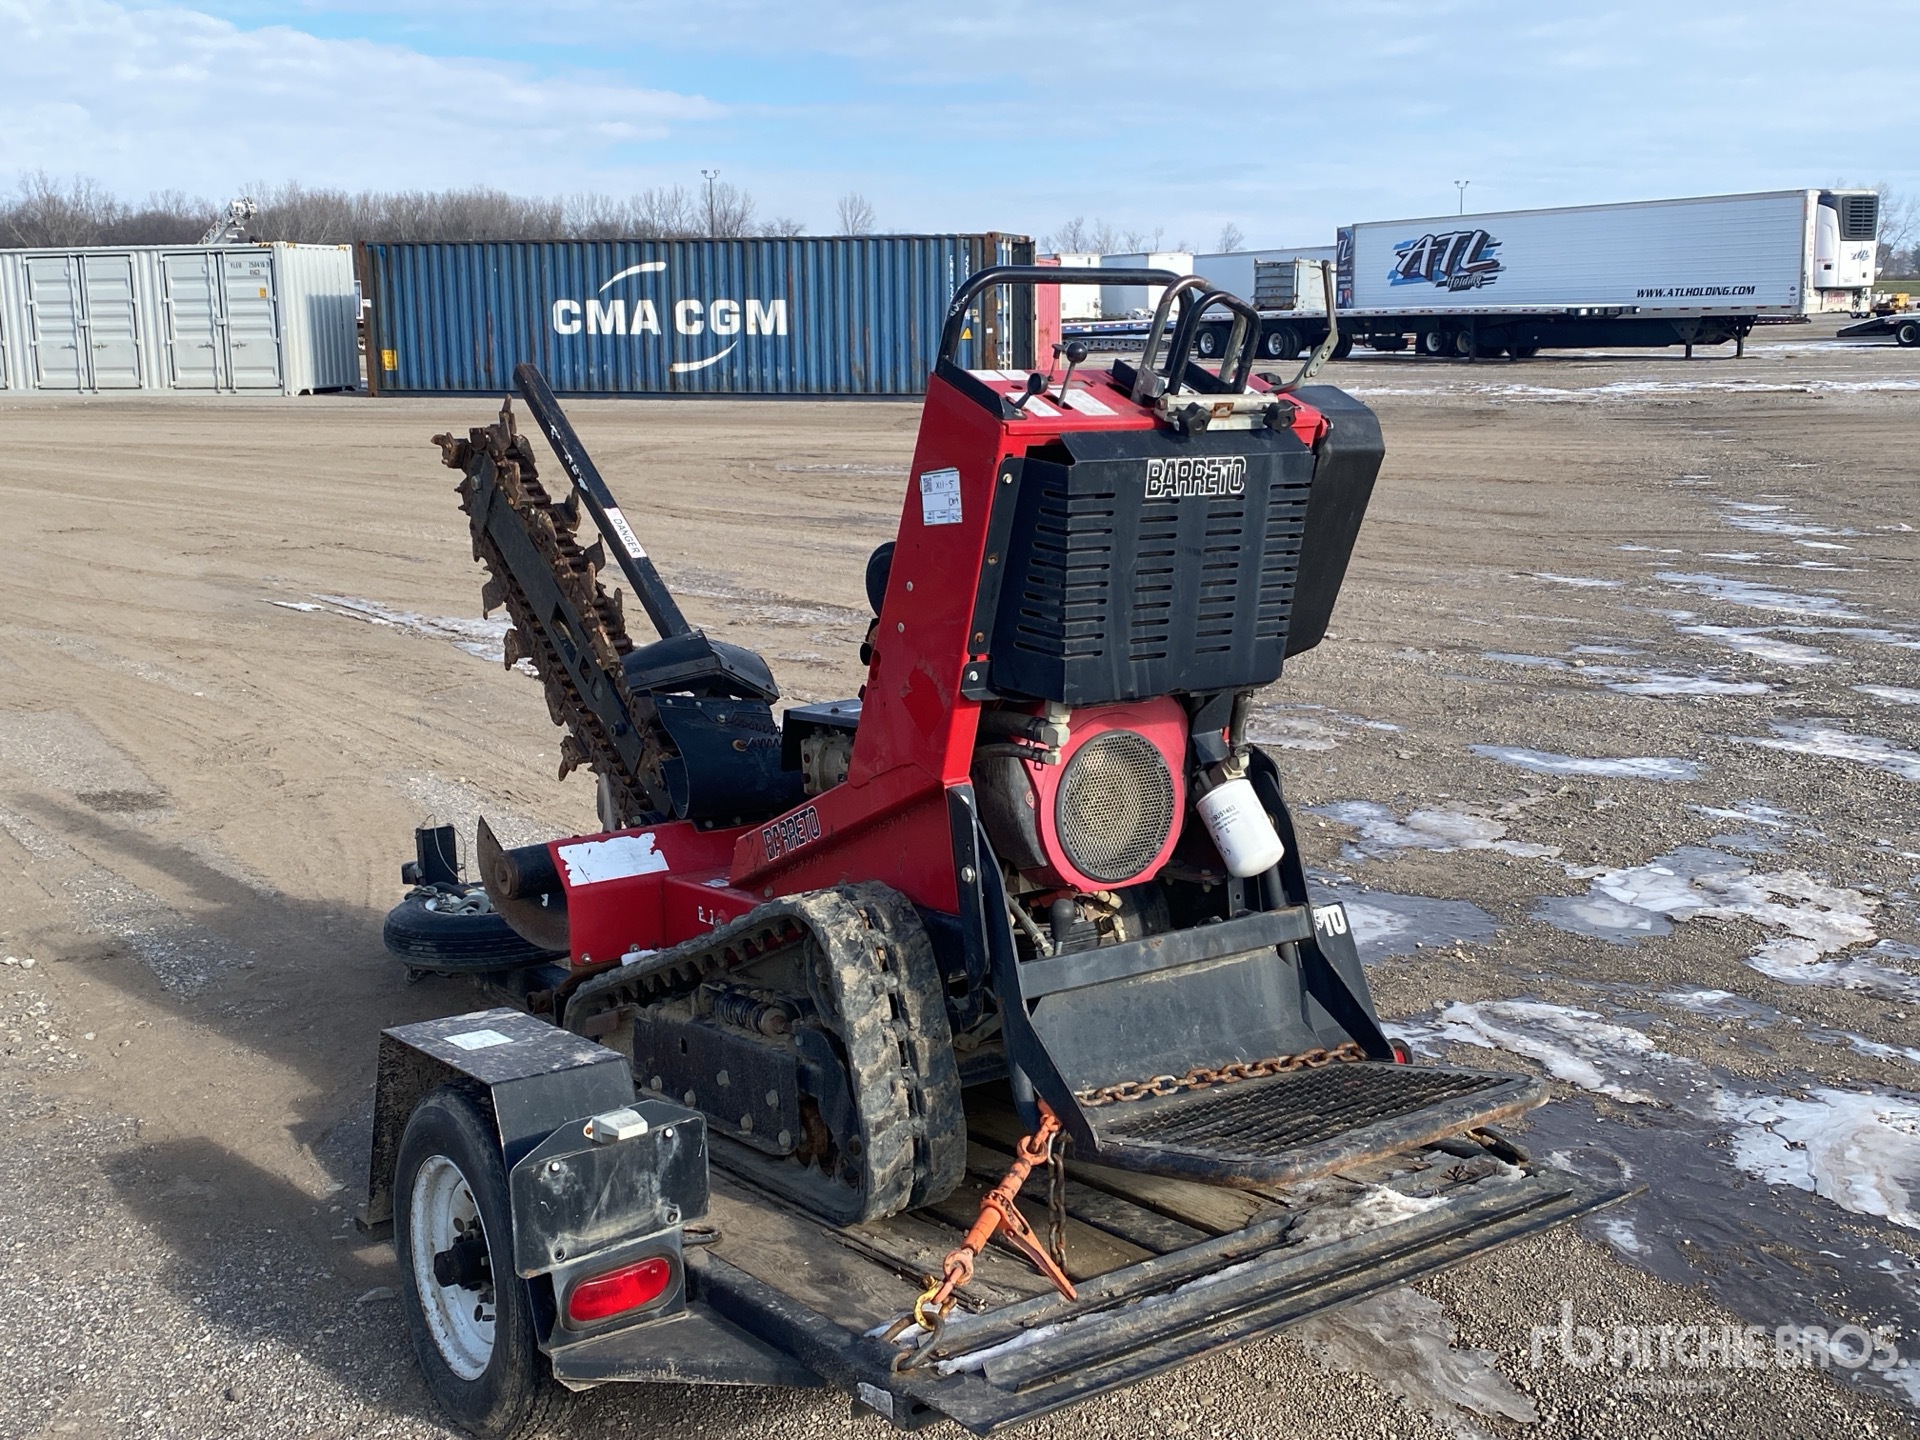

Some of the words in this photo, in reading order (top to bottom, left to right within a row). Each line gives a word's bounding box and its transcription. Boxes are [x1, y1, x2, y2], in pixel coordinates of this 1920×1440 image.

[1395, 229, 1500, 281] ATL
[1447, 275, 1482, 288] Holding
[1636, 286, 1756, 298] WWW.ATLHOLDING.COM
[552, 299, 661, 335] CMA
[674, 299, 788, 335] CGM
[1145, 456, 1246, 498] BARRETO
[613, 518, 641, 553] DANGER
